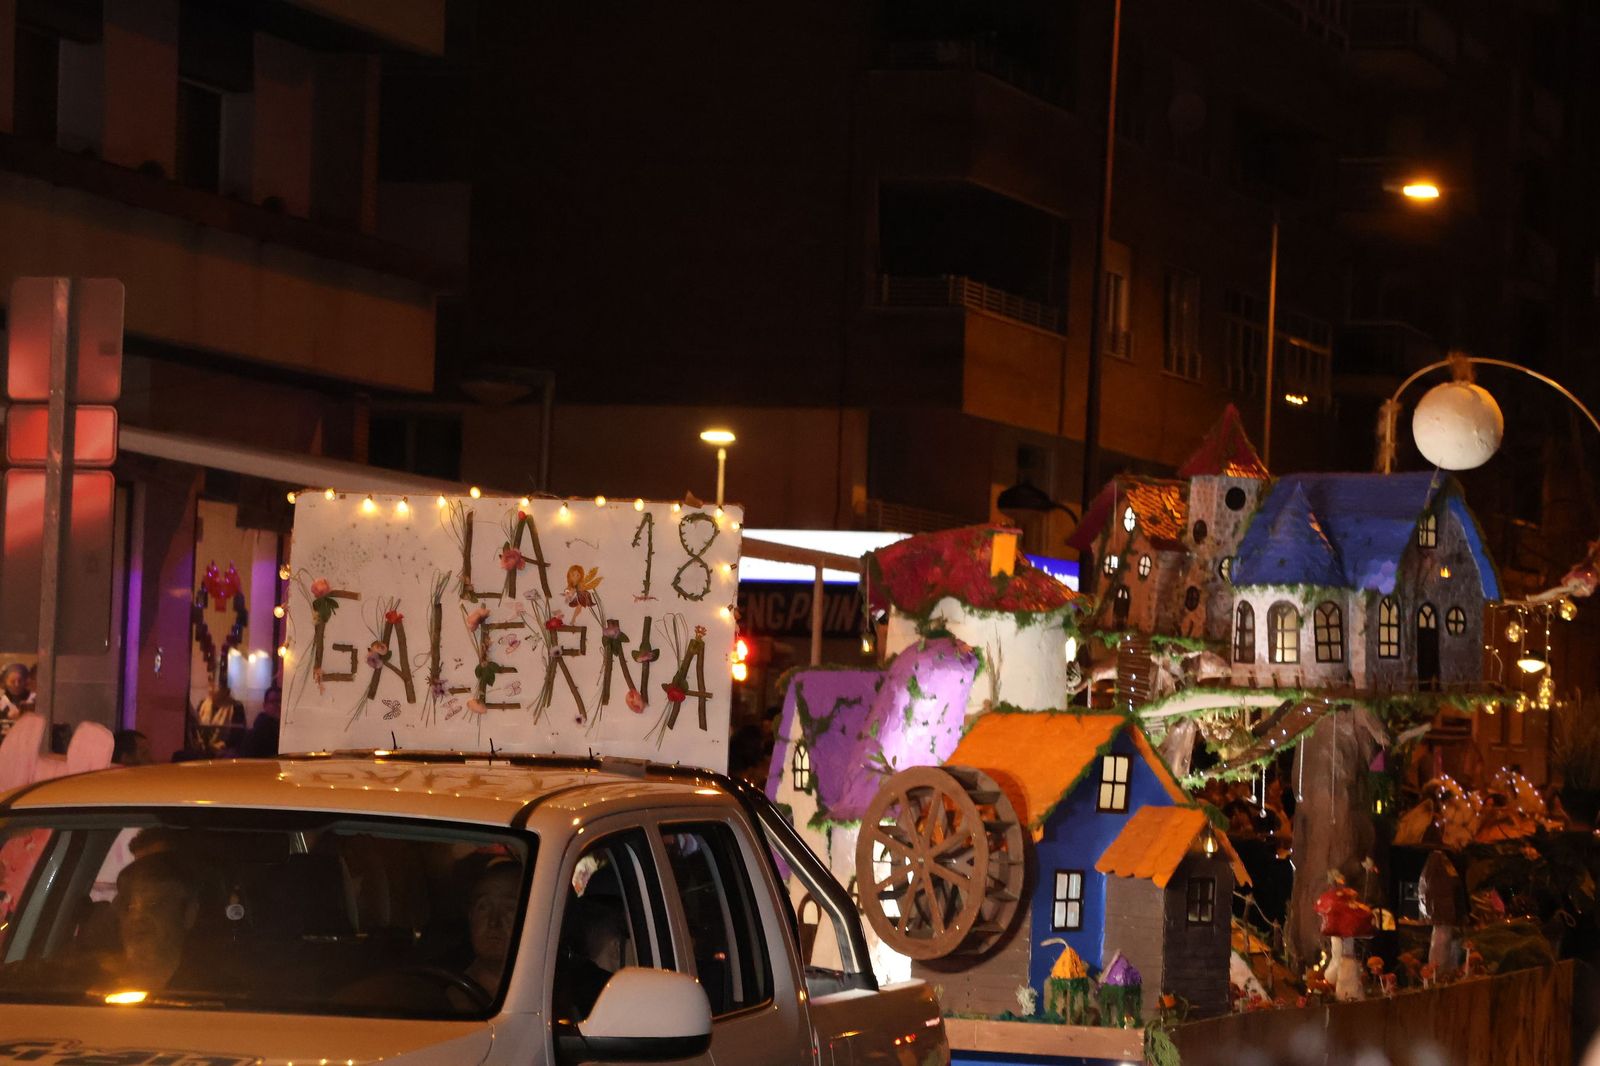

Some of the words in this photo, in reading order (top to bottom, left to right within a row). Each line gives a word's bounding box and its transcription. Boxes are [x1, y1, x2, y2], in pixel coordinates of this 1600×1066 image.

[461, 510, 552, 602] LA
[631, 511, 720, 601] 18
[310, 584, 714, 731] GALERNA
